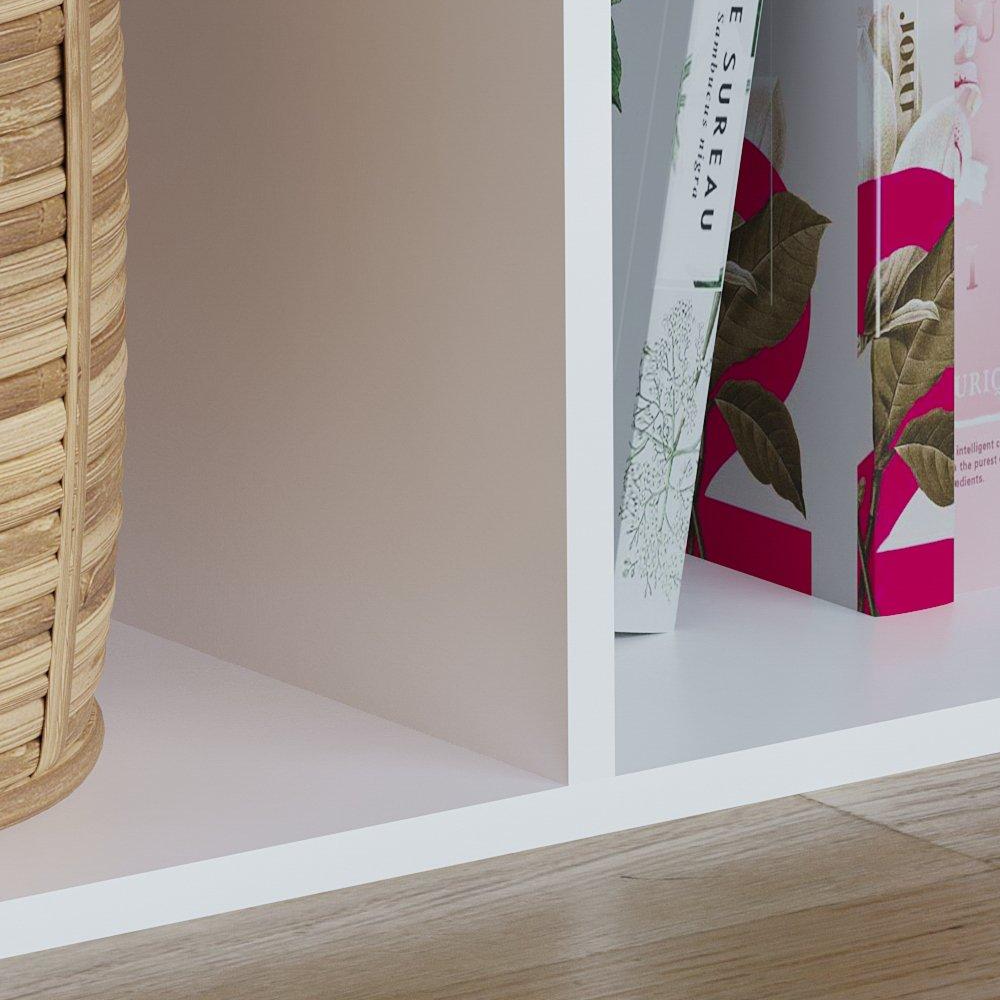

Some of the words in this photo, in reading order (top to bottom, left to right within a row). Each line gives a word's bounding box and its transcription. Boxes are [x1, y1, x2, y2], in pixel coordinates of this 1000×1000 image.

[701, 11, 726, 128] Sambucus
[899, 11, 916, 113] mor
[690, 138, 706, 200] nigra
[700, 52, 736, 232] SUREAU
[956, 439, 994, 456] intelligent
[959, 459, 972, 472] the
[974, 456, 997, 472] purest
